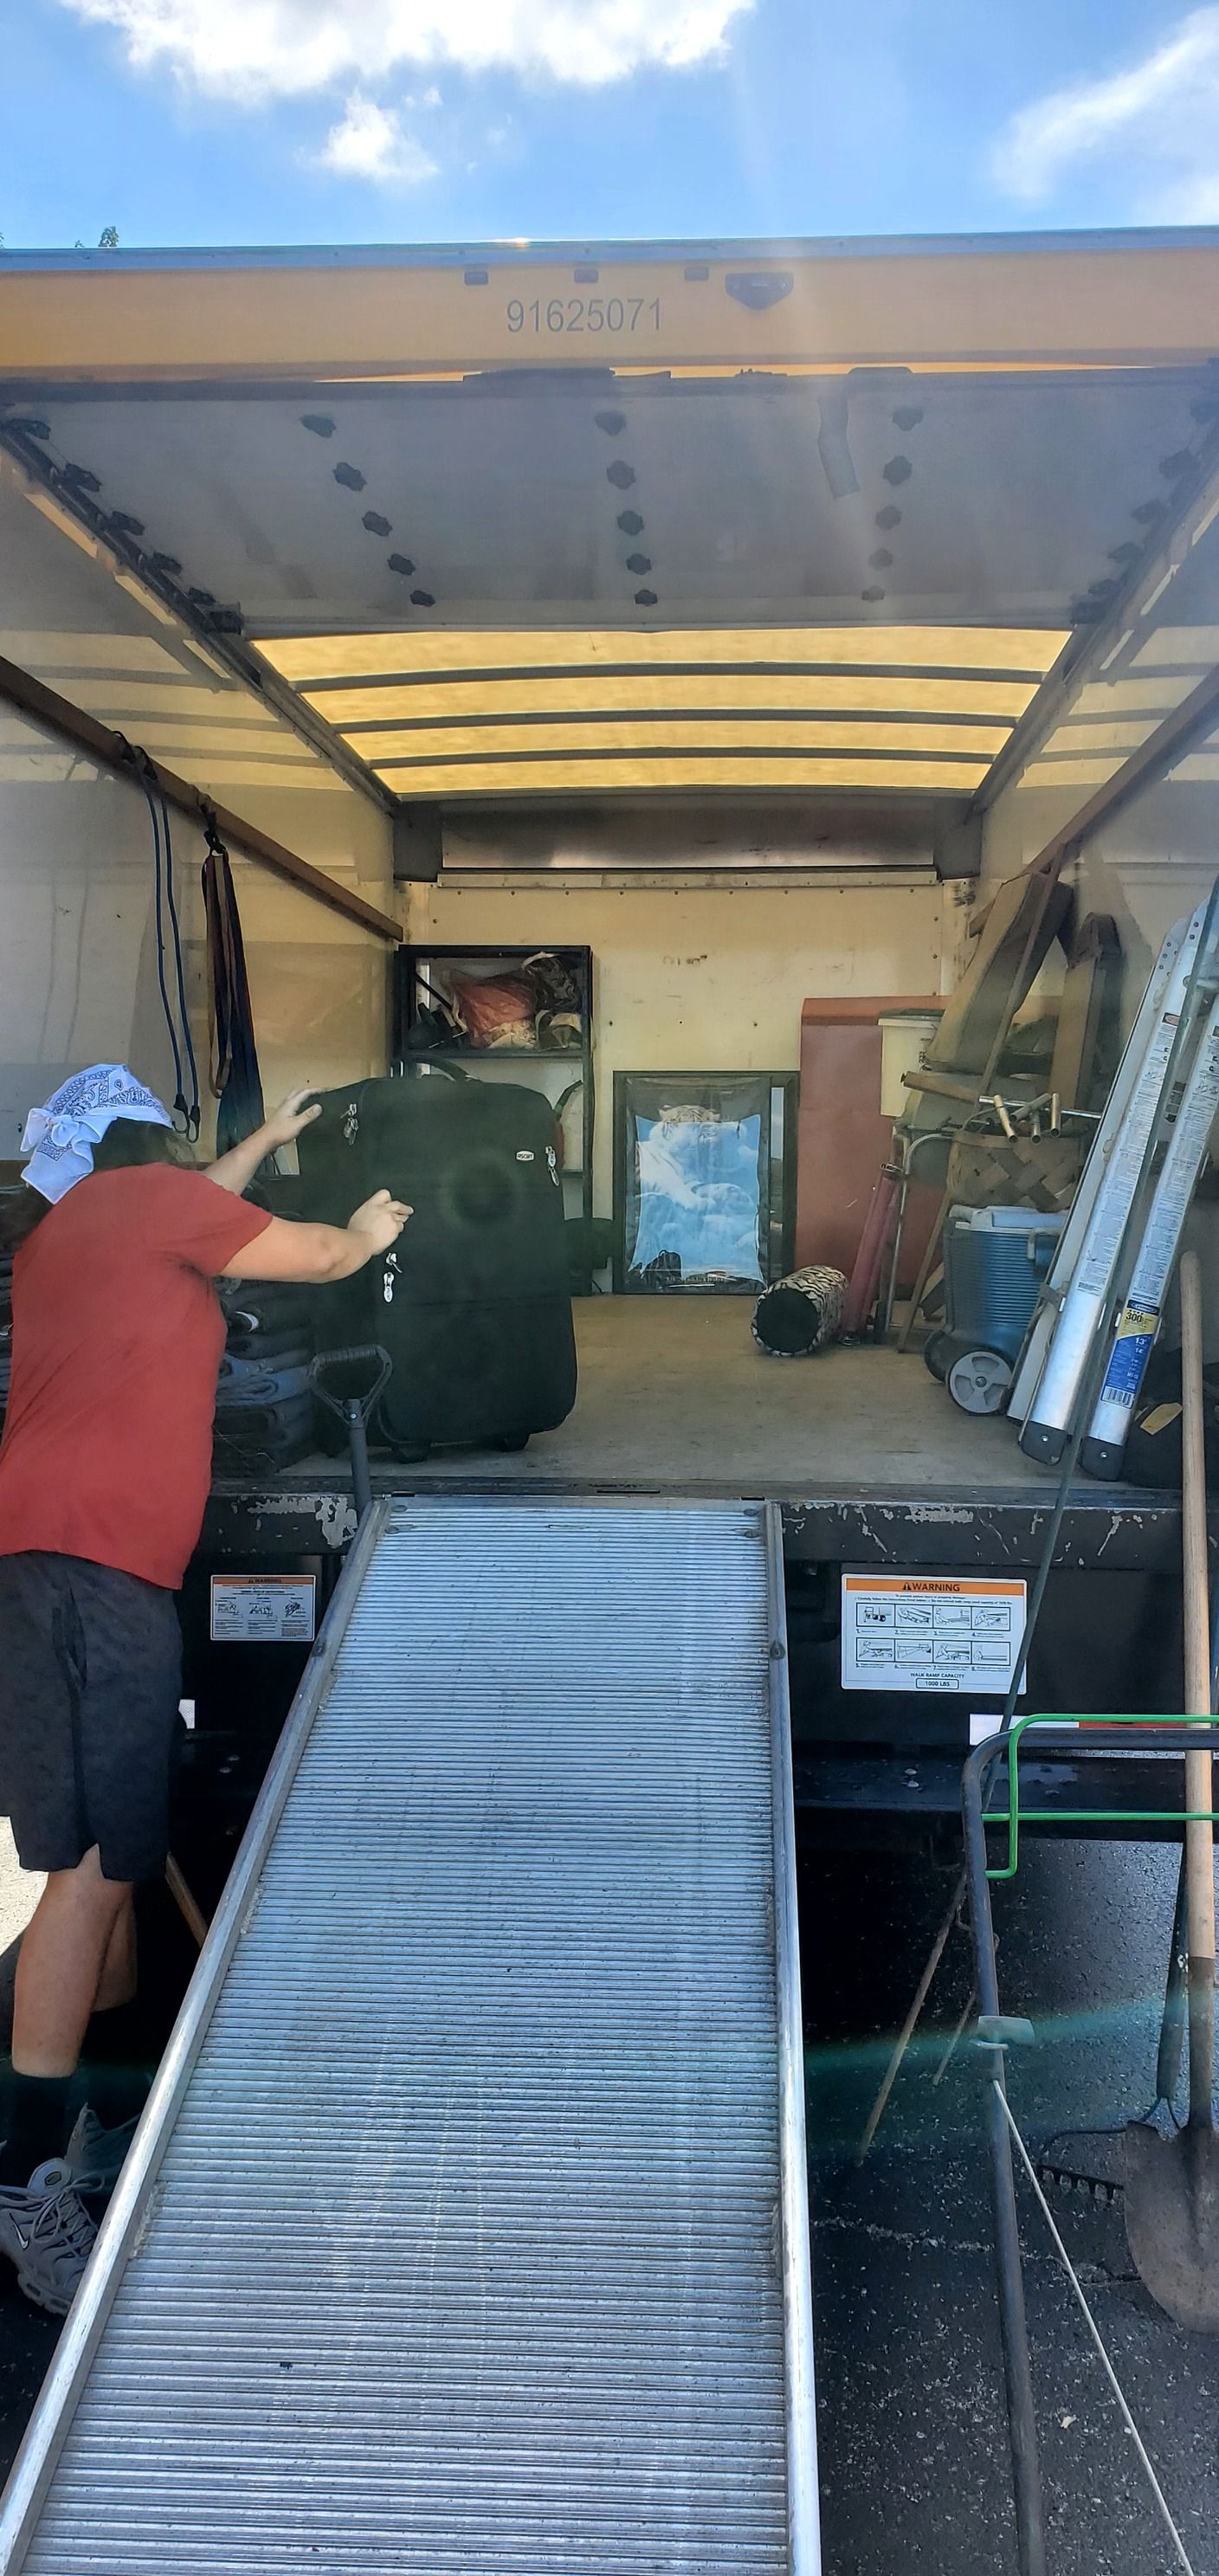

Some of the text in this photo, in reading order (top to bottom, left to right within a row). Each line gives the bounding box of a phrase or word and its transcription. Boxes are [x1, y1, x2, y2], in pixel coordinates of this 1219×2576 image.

[506, 298, 662, 333] 91625071
[1125, 1313, 1143, 1323] 300
[912, 1583, 960, 1591] WARNING
